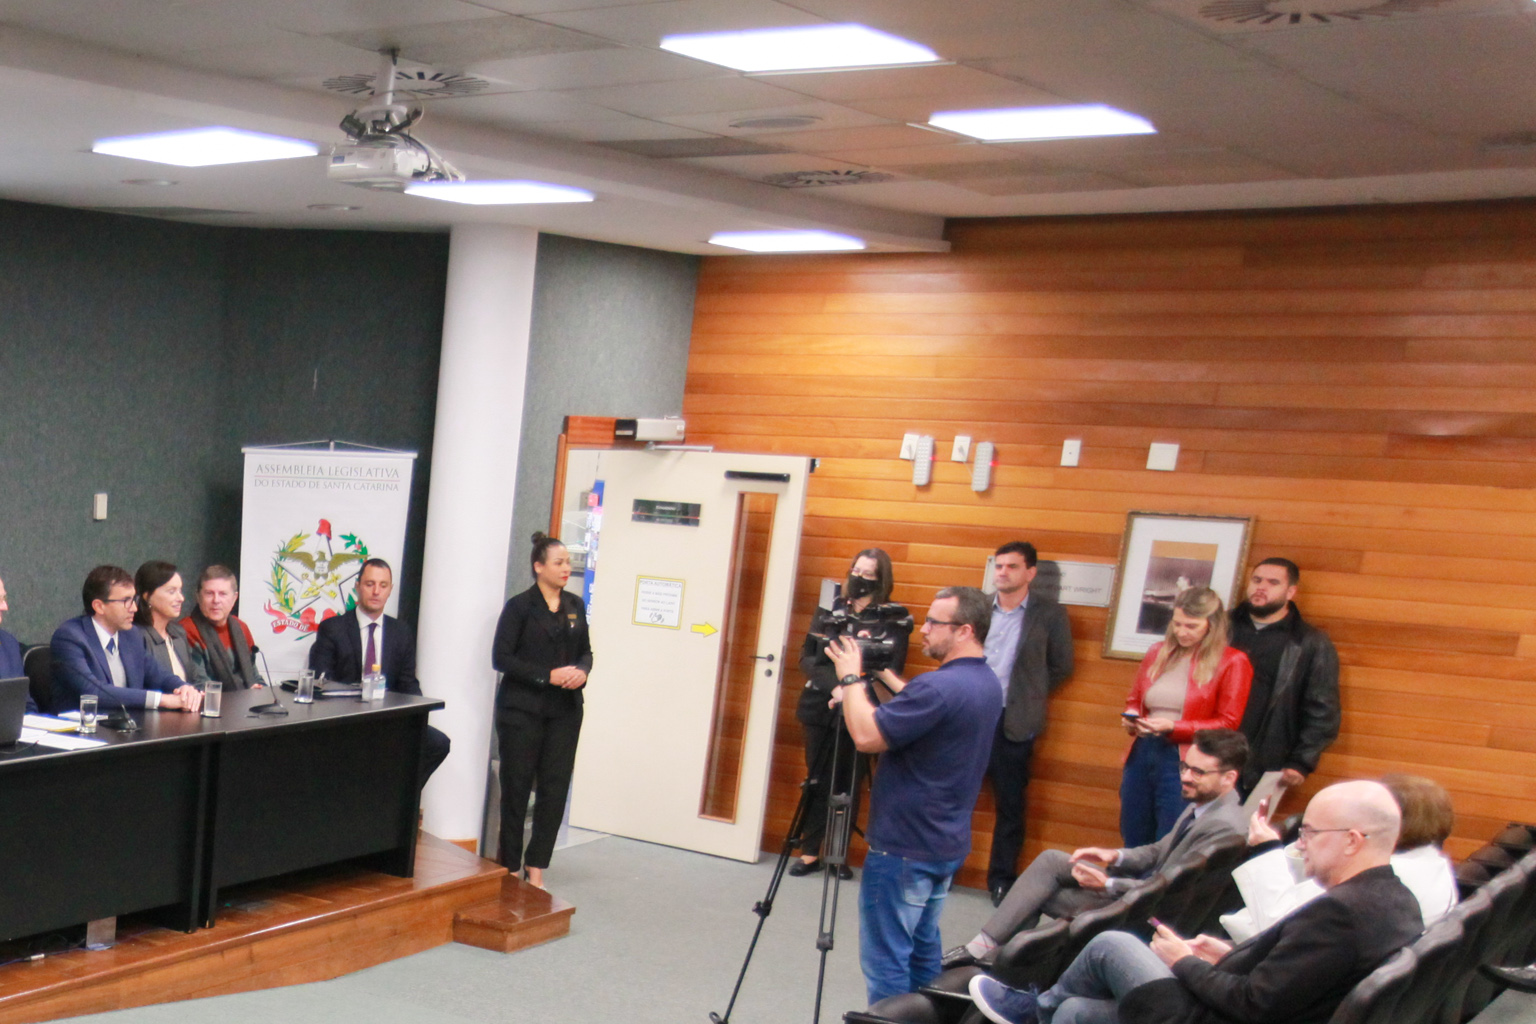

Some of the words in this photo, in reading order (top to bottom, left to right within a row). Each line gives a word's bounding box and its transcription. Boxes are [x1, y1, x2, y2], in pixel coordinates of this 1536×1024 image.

[255, 464, 324, 476] ASSEMBLEIA
[328, 466, 400, 478] LEGISLATIVA
[254, 479, 269, 487] DO
[271, 479, 306, 489] ESTADO
[308, 480, 321, 489] DE
[323, 481, 352, 490] SANTA
[353, 482, 399, 492] CATARINA
[1073, 586, 1102, 594] WRIGHT
[272, 619, 299, 628] ESTADO
[299, 623, 310, 631] DE
